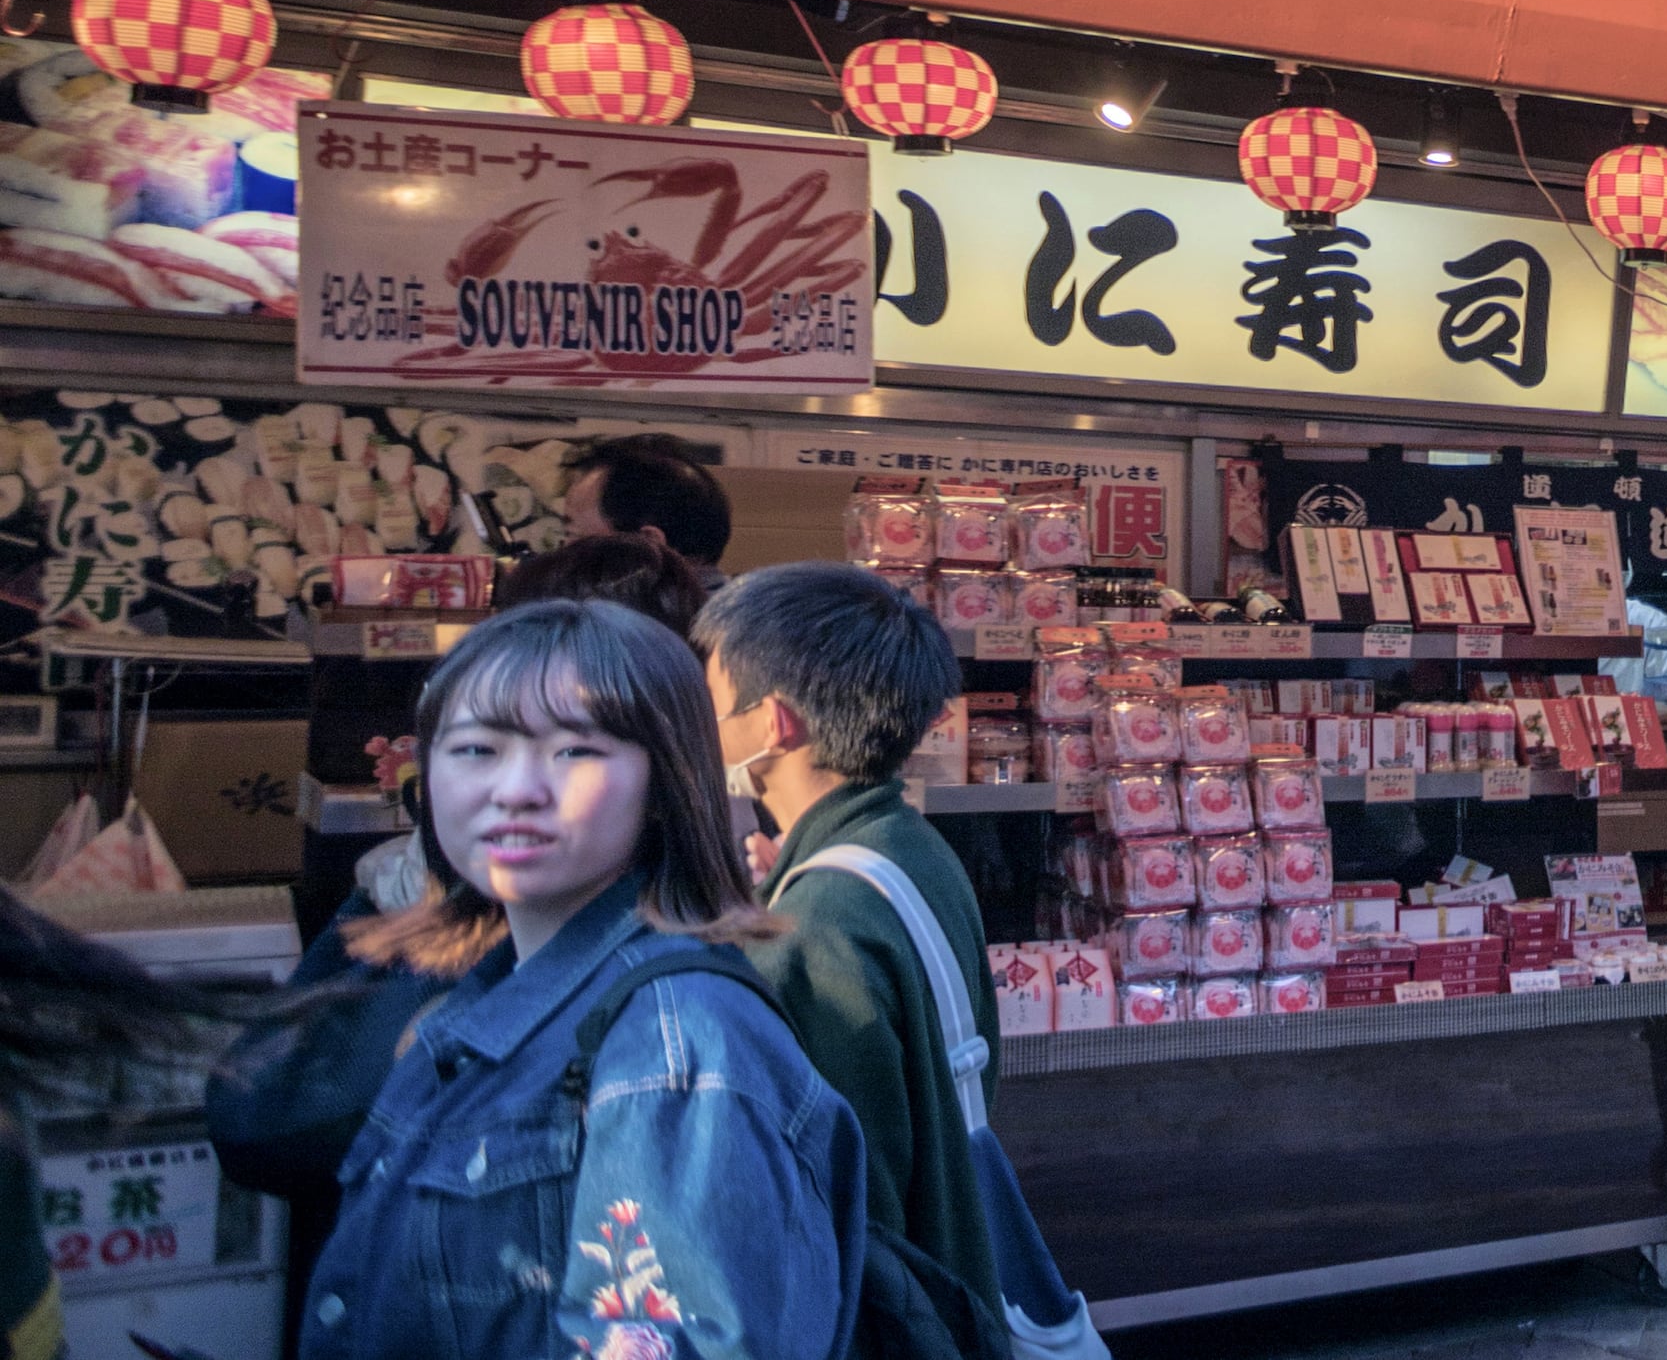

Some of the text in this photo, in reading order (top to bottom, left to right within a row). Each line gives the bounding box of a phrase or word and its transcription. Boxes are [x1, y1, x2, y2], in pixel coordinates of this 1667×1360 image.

[316, 126, 591, 180] お土産コーナー
[319, 273, 427, 348] 紀念品店
[456, 276, 746, 357] SOUVENIR SHOP
[797, 447, 1160, 483] ご家庭・ご贈答に かに専門店のおいしさを
[46, 415, 158, 688] かに寿
